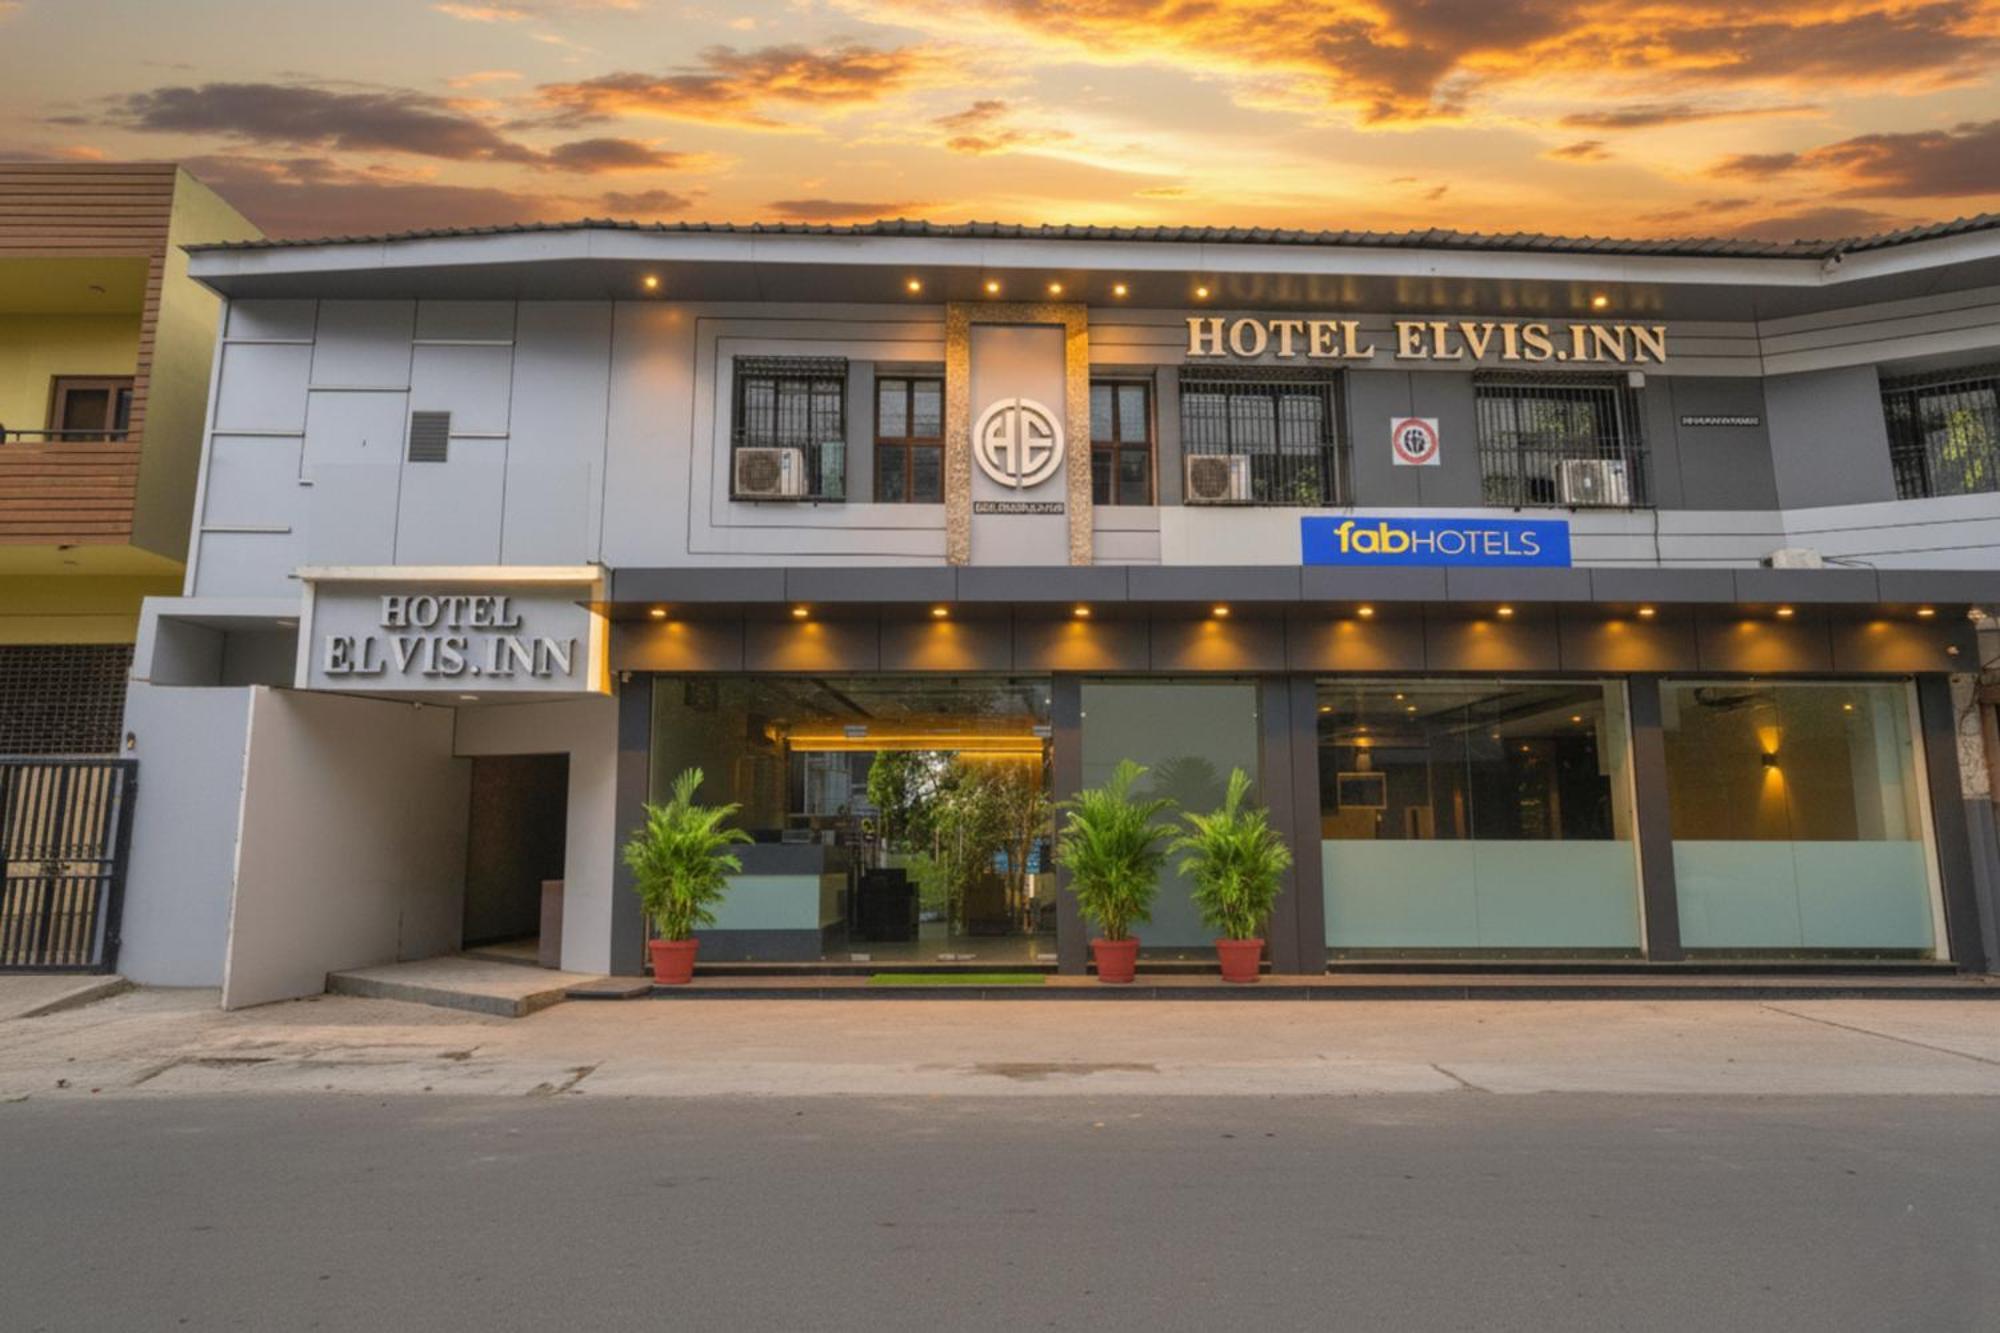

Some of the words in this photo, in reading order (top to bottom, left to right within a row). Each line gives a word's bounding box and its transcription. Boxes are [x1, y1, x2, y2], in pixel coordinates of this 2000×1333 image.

[1185, 317, 1374, 359] HOTEL
[1395, 320, 1667, 365] ELVIS.INN
[380, 595, 522, 628] HOTEL
[323, 635, 576, 676] ELVIS.INN
